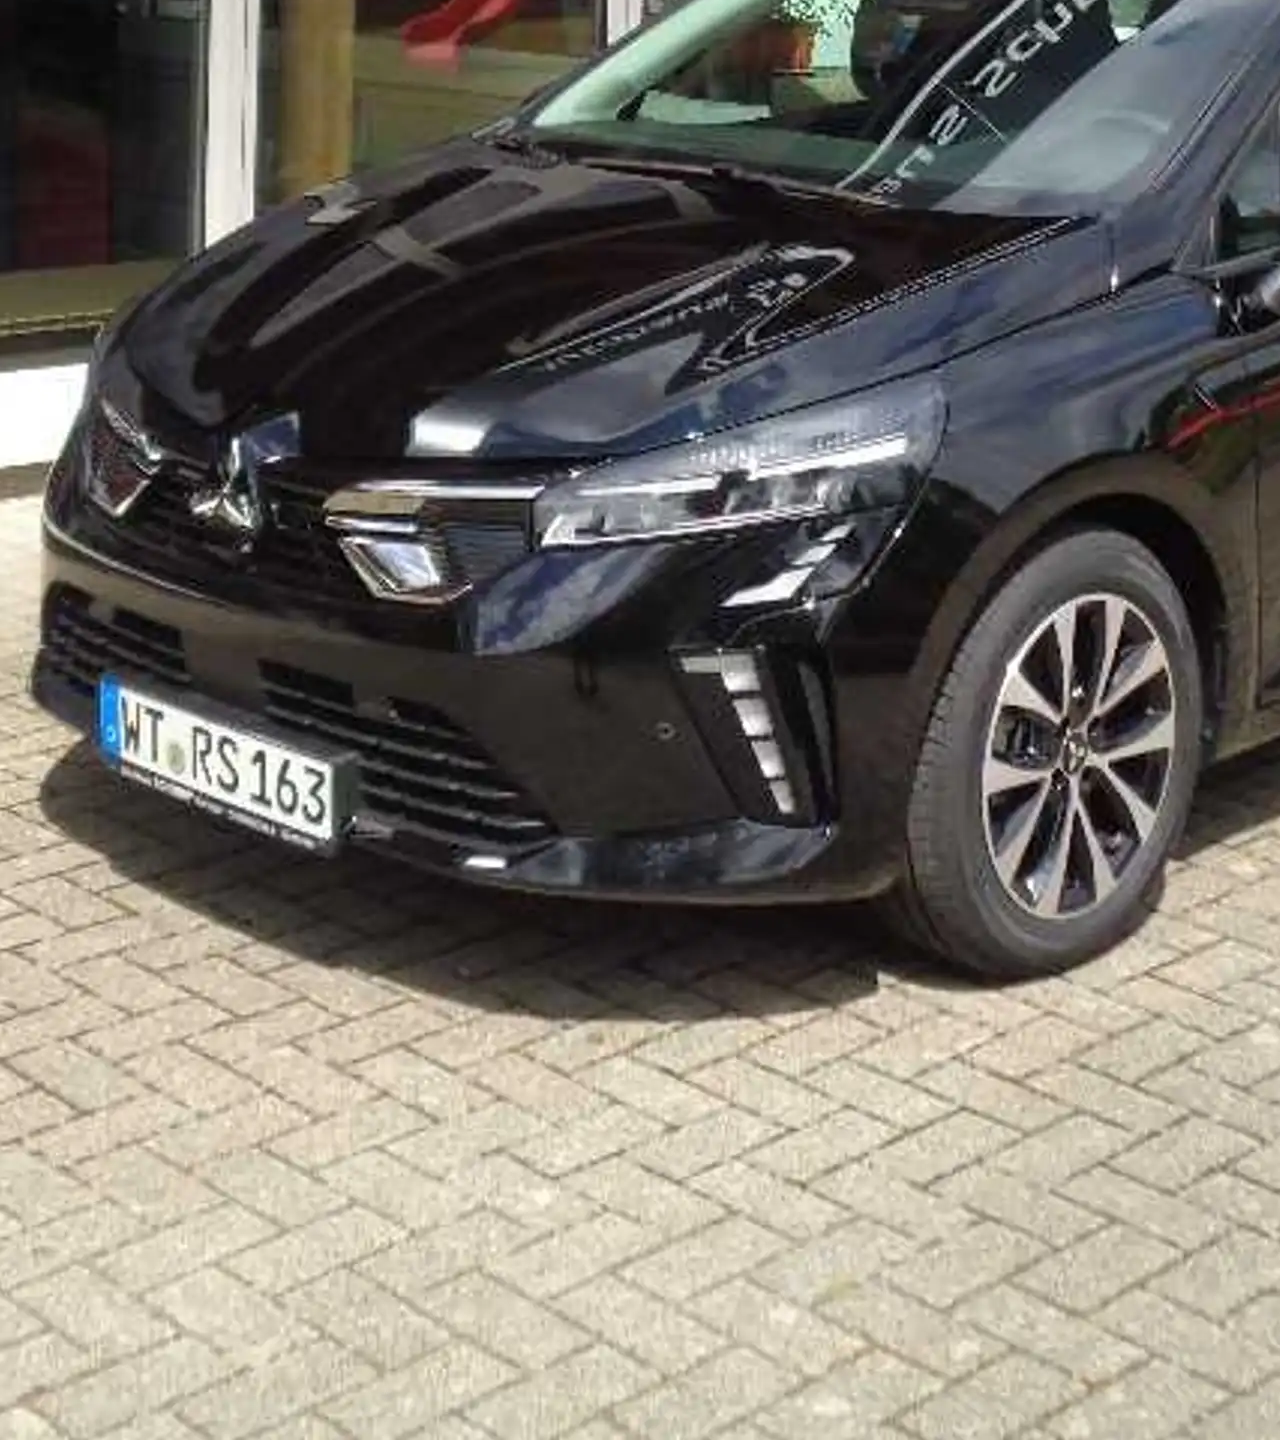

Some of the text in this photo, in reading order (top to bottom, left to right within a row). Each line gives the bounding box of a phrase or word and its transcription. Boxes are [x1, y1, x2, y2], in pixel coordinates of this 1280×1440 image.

[121, 696, 164, 763] WT
[192, 726, 239, 794] RS
[250, 749, 326, 825] 163
